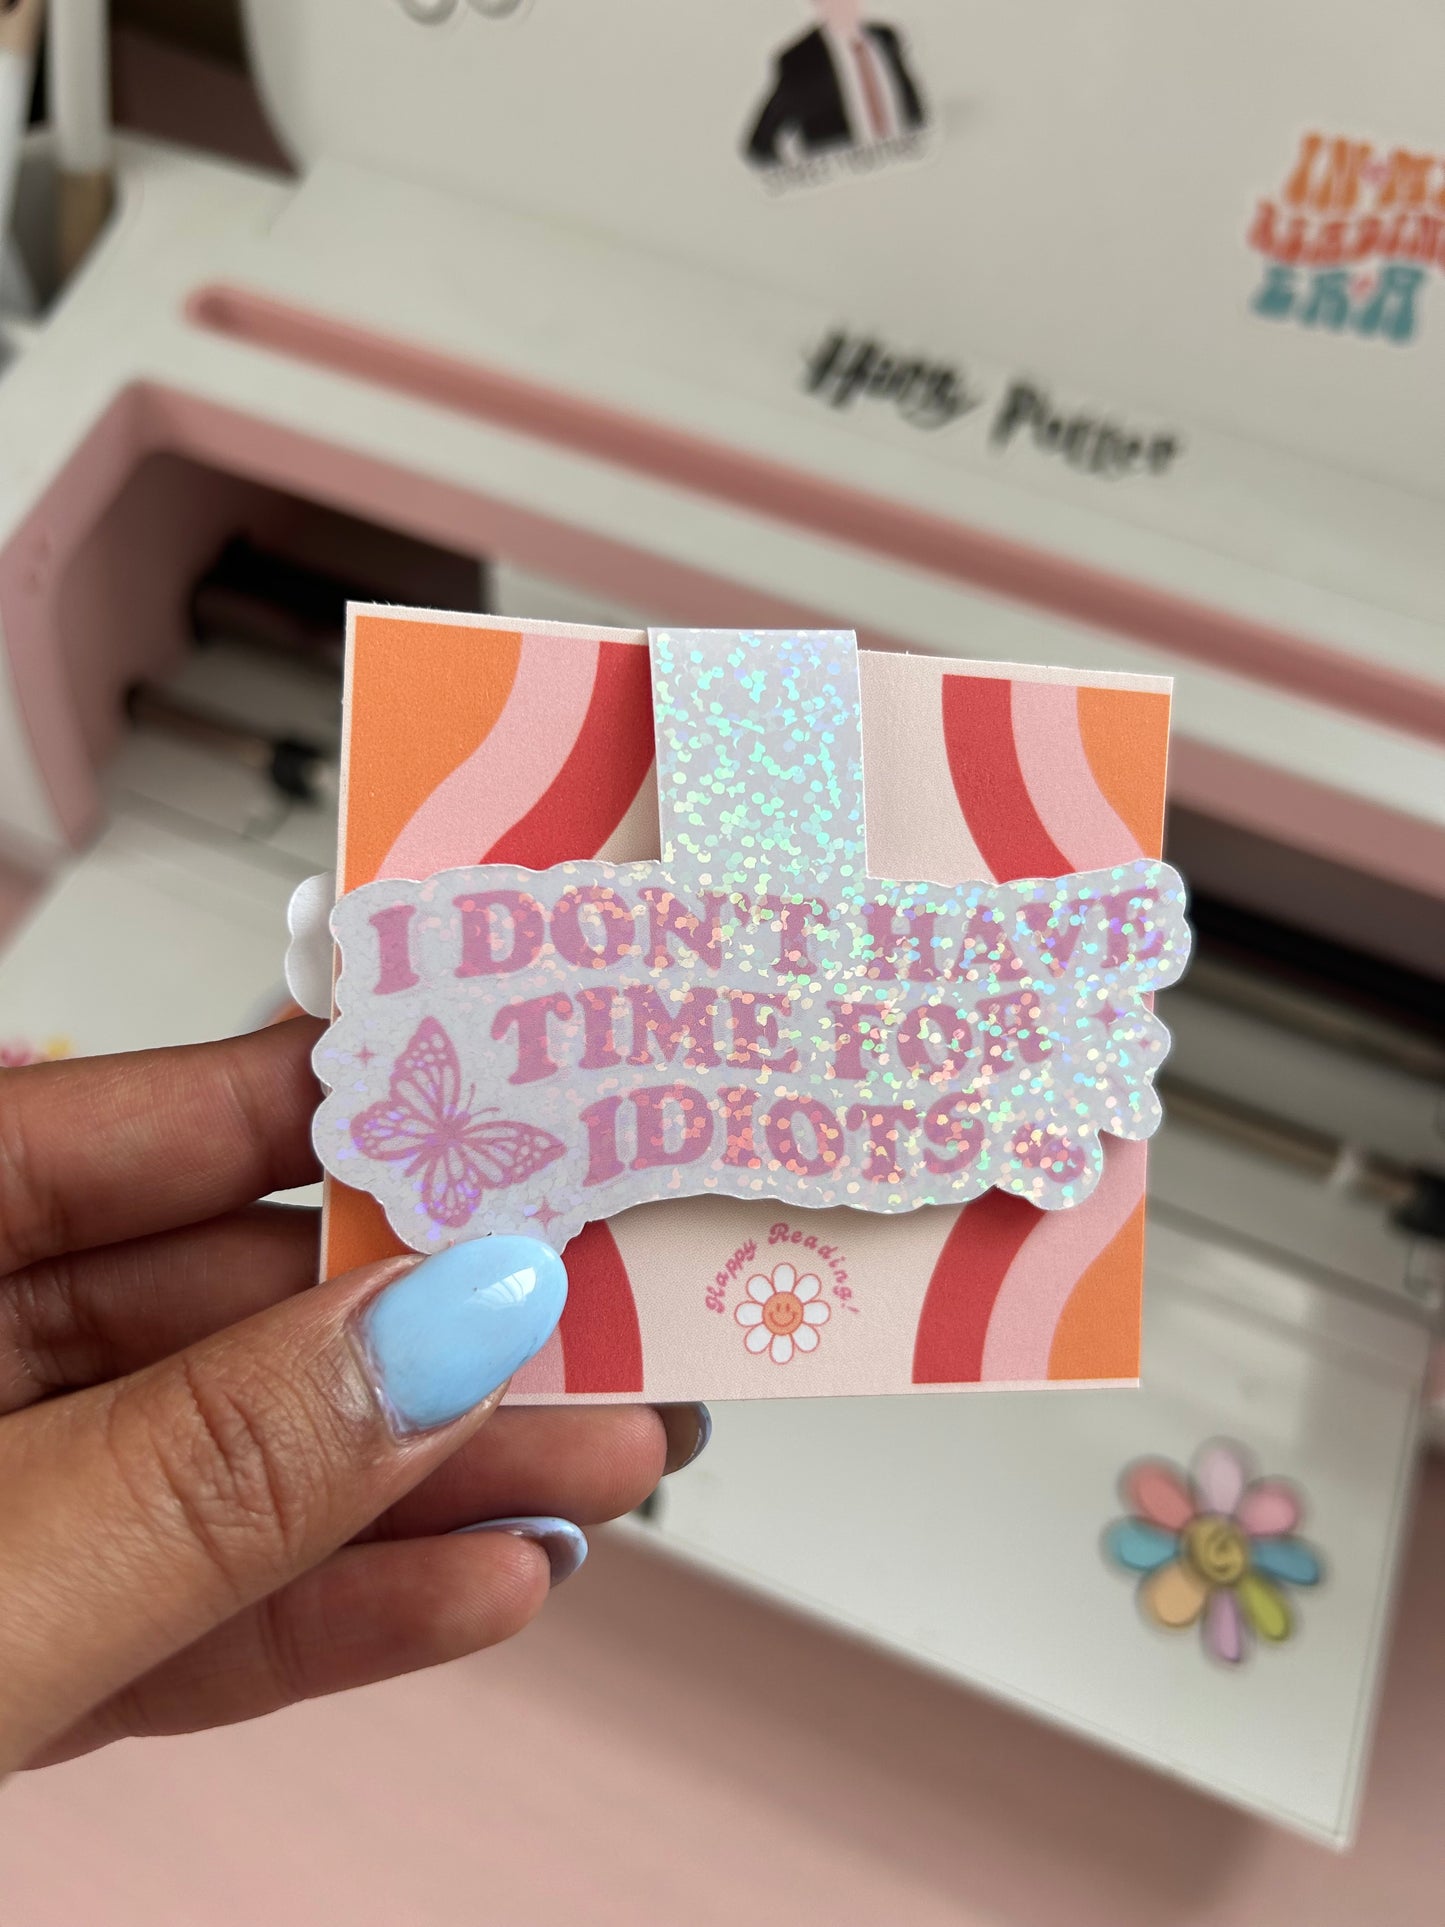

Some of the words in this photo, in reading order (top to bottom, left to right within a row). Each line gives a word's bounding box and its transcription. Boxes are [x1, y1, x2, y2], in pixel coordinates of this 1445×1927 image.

[369, 905, 419, 995] I
[452, 886, 830, 979] DON'T
[862, 887, 1167, 982] HAVE
[491, 984, 799, 1085] TIME
[826, 989, 1053, 1081] FOR
[579, 1084, 986, 1187] IDIOTS
[705, 1238, 757, 1313] Happy
[768, 1222, 860, 1313] Reading!
